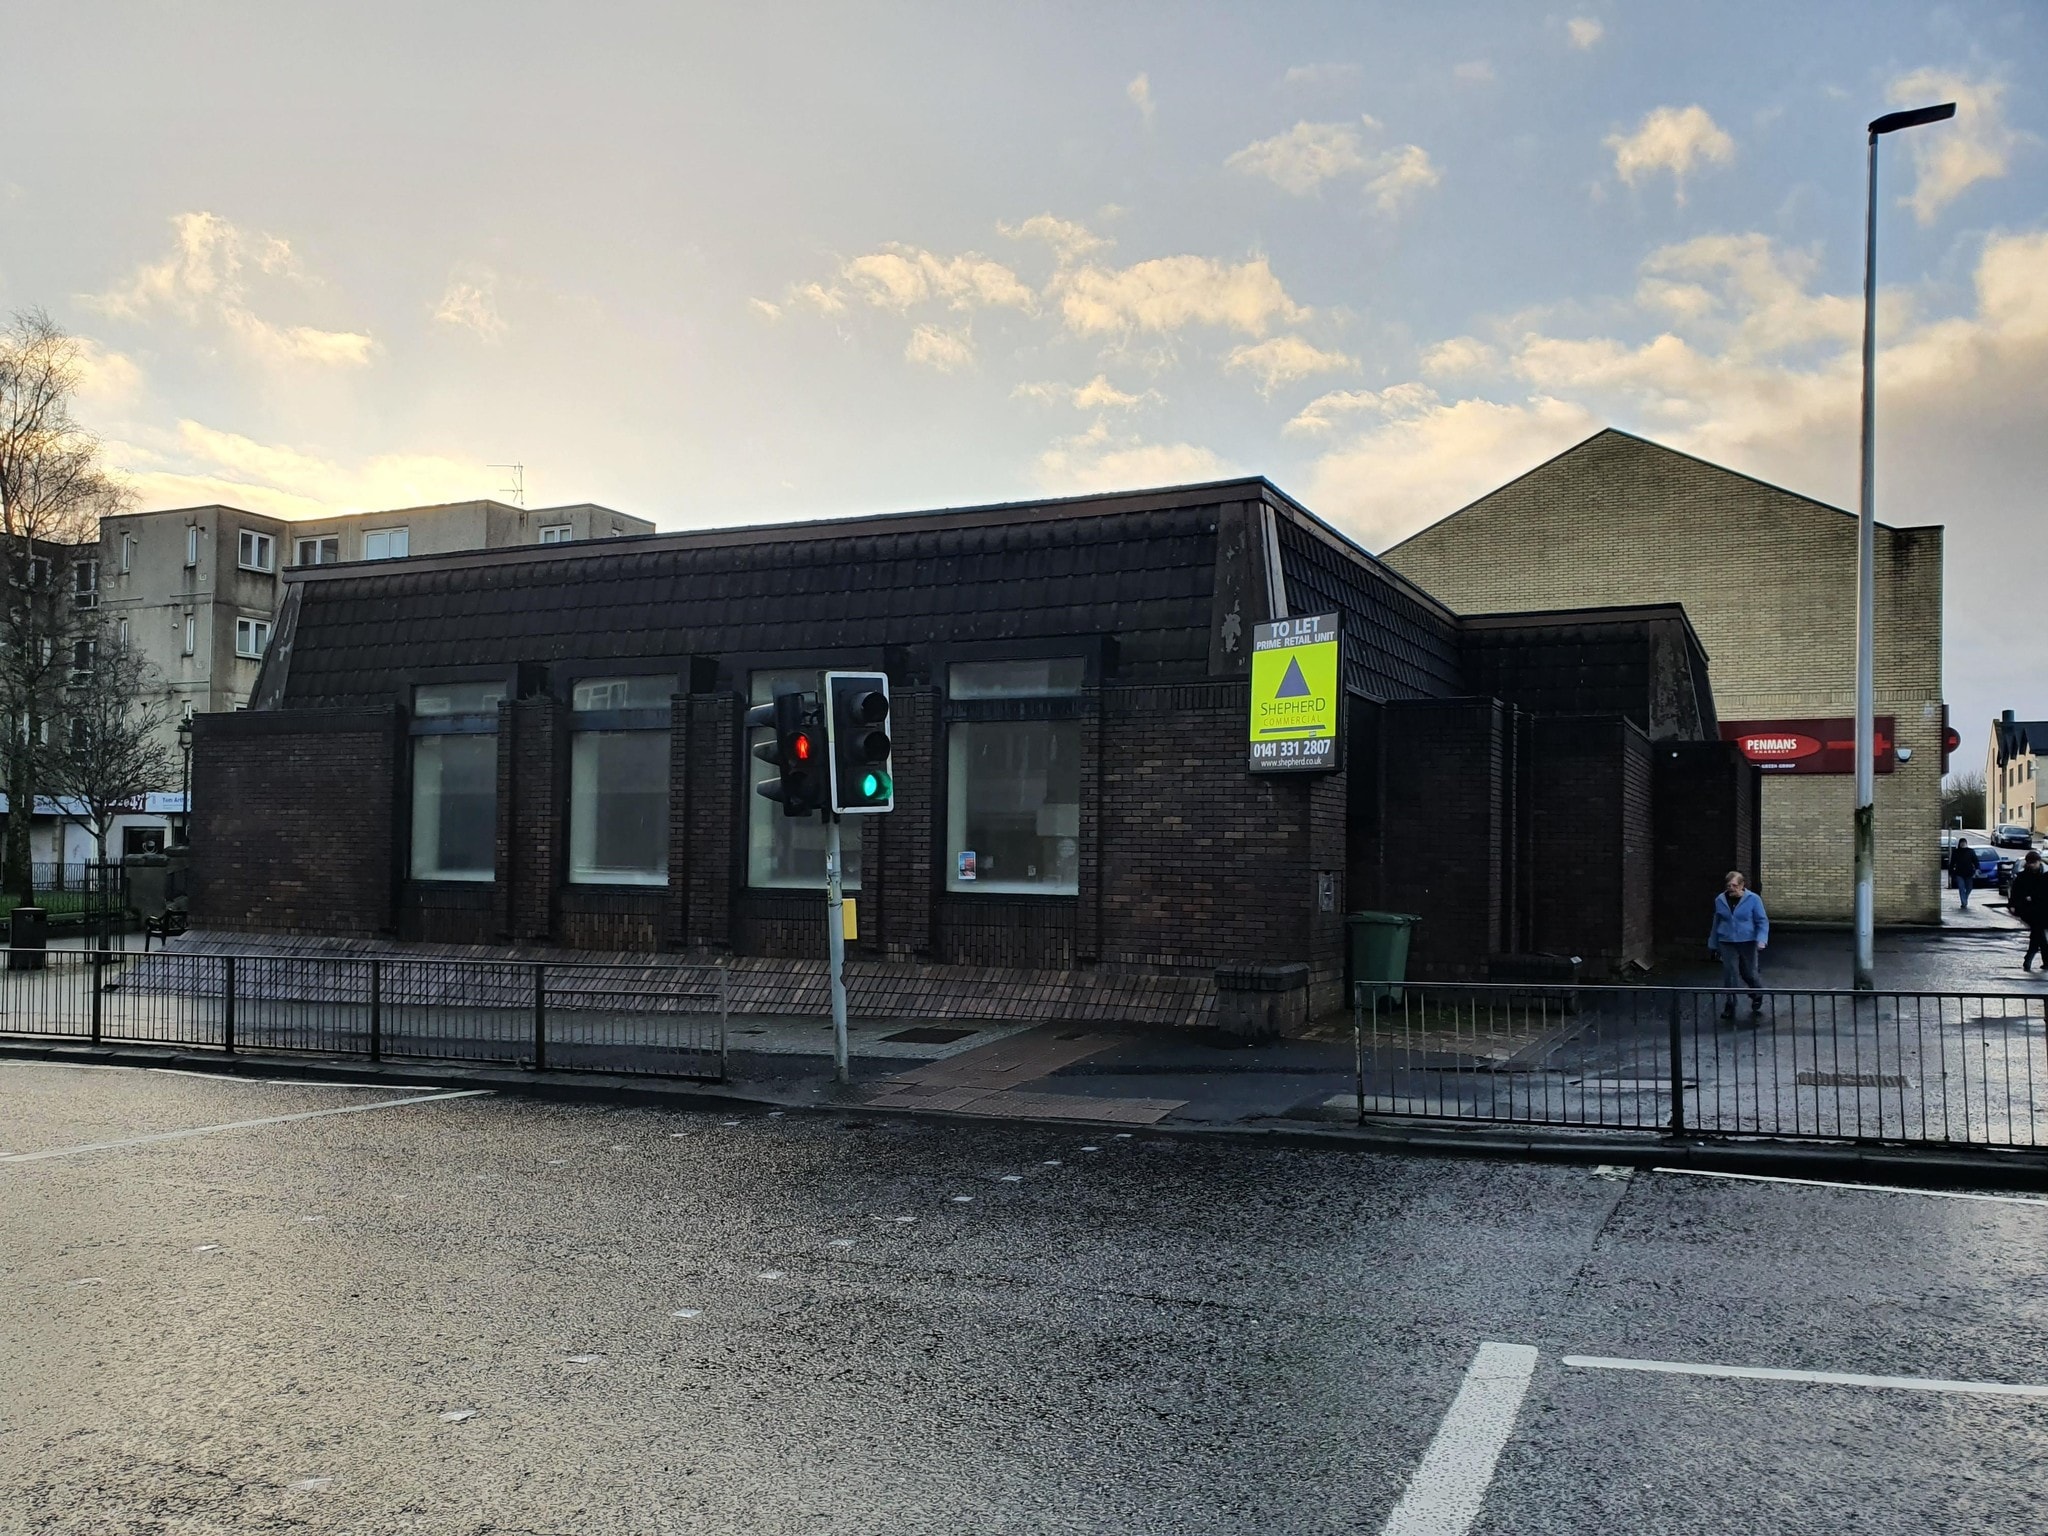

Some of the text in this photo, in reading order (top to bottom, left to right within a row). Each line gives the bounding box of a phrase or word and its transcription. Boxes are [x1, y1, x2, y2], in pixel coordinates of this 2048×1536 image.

[1271, 616, 1321, 638] TO LET
[1256, 631, 1335, 650] PRIME RETAIL UNIT
[1260, 698, 1326, 716] SHEPHERD
[1263, 715, 1321, 726] COMMERCIAL
[1253, 739, 1331, 758] 0141 331 2807
[1747, 739, 1797, 750] PENMANS
[1261, 757, 1322, 767] www.shepherd.co.uk
